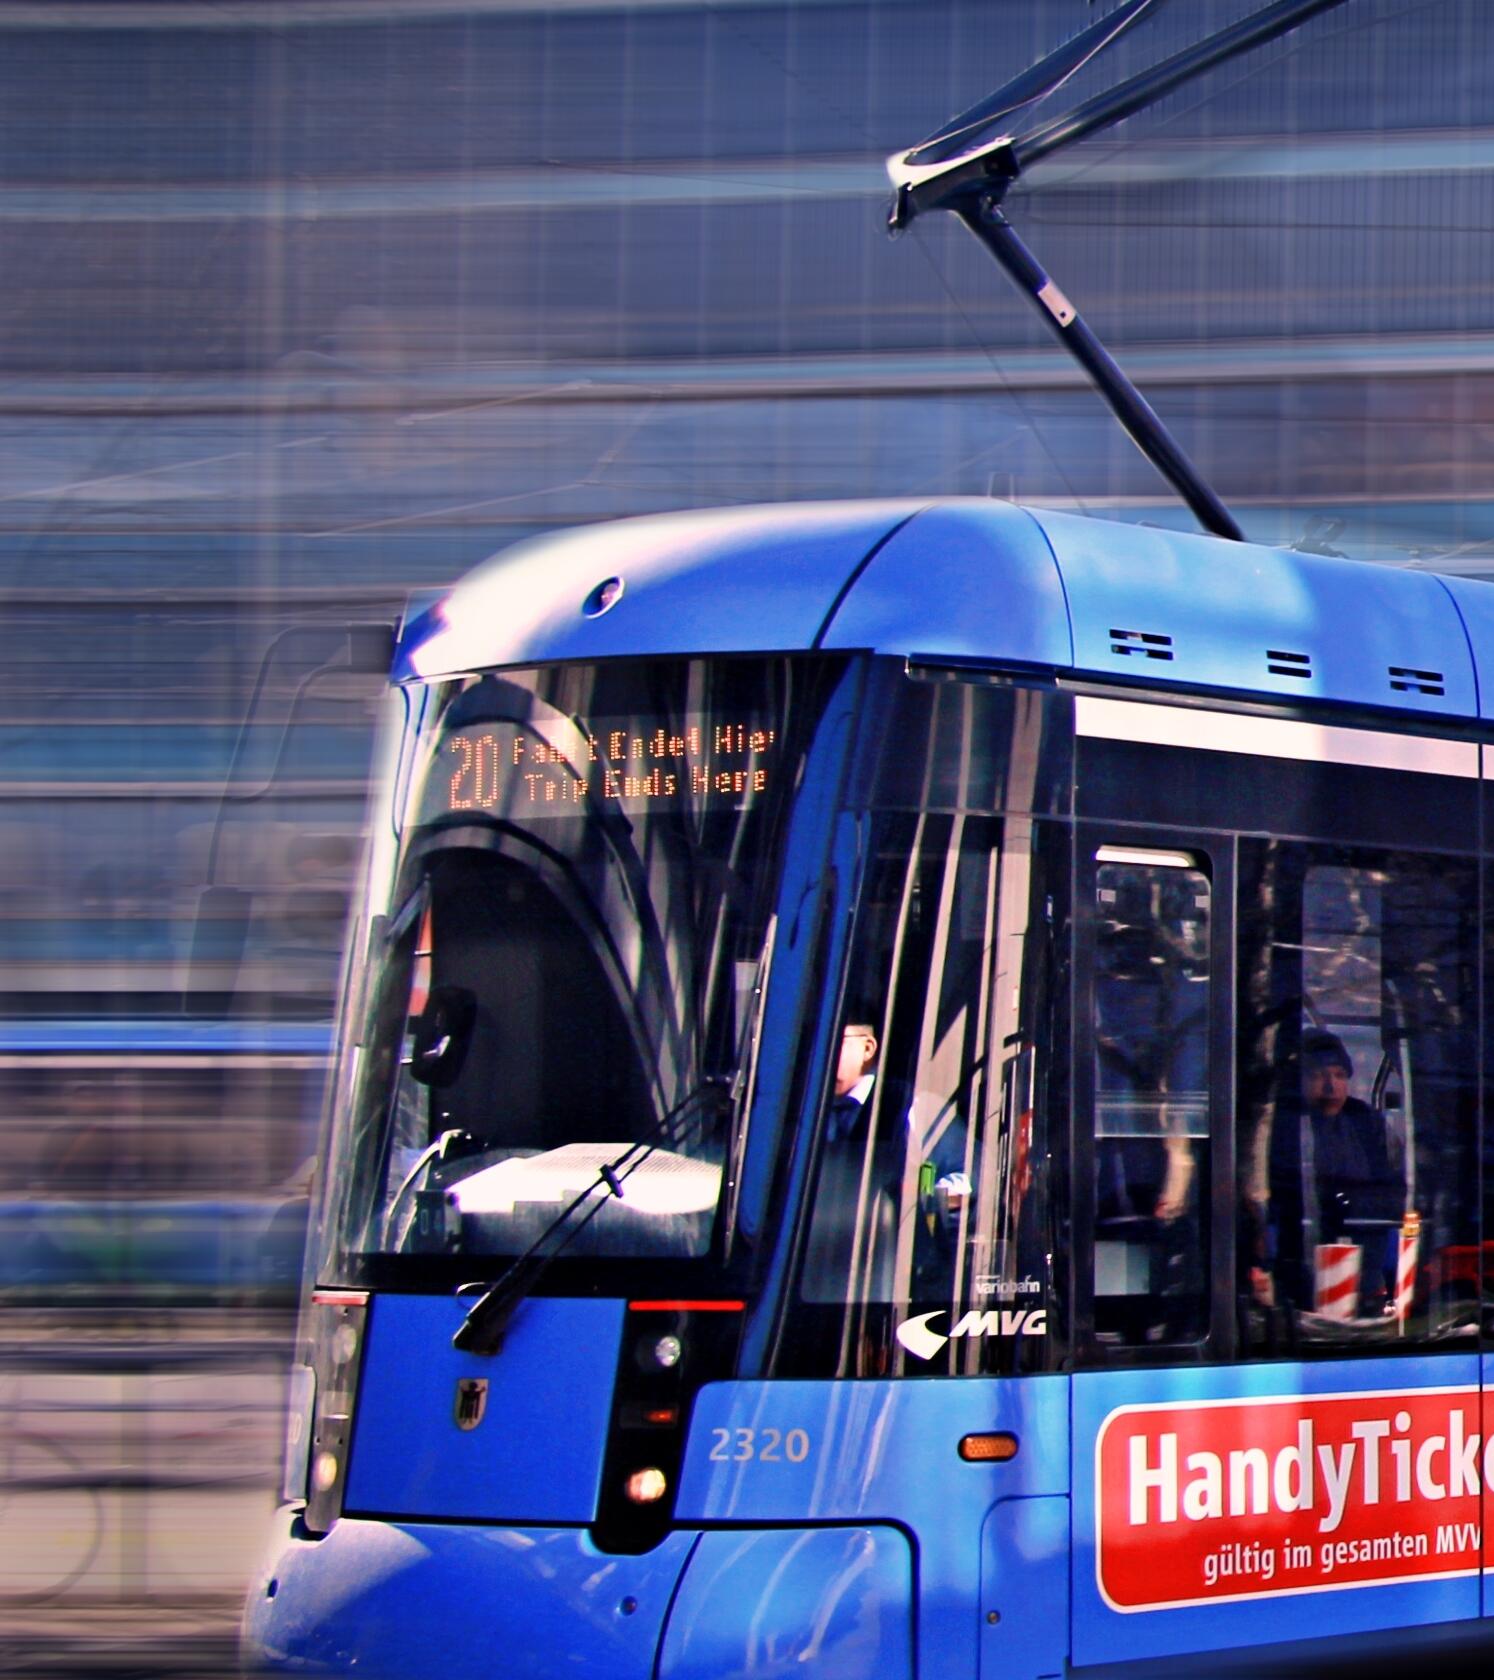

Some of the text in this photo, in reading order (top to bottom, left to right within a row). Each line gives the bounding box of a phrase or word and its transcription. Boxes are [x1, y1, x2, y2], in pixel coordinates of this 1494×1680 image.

[450, 735, 498, 809] 20
[524, 765, 767, 802] Trip Ends Here
[949, 1310, 1046, 1337] MVG
[709, 1428, 810, 1462] 2320
[1203, 1523, 1481, 1586] gültig im gesamten MVV
